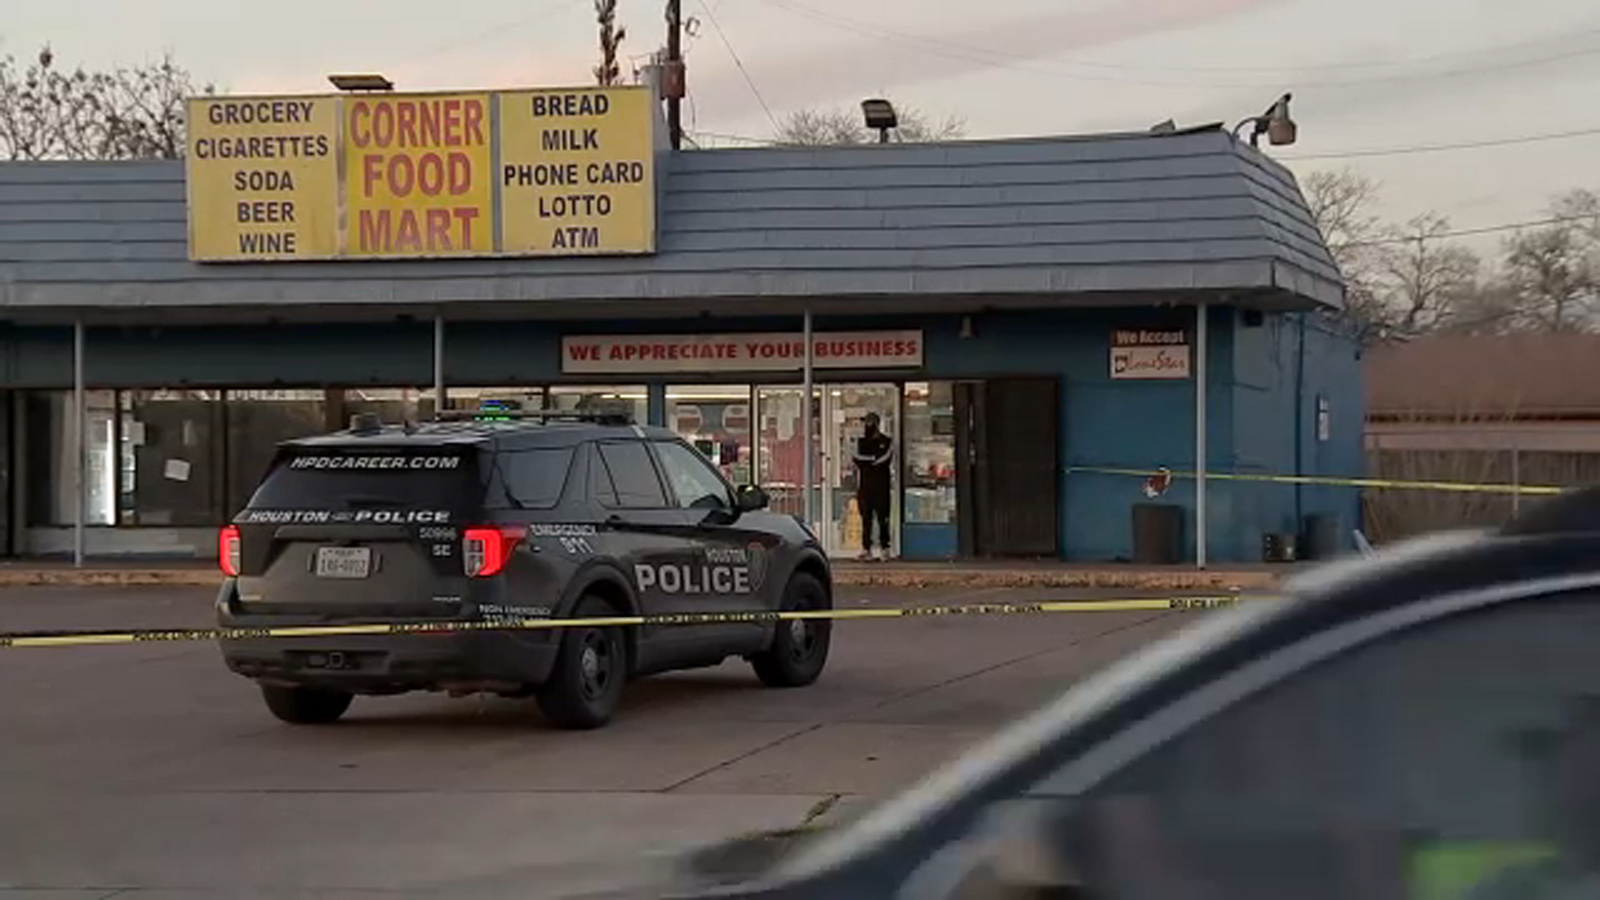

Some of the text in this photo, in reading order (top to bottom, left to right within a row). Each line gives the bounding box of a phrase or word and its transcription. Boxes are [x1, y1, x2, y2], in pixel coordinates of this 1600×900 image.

[208, 102, 314, 124] GROCERY
[532, 94, 609, 117] BREAD
[350, 99, 484, 148] CORNER
[195, 135, 329, 159] CIGARETTES
[542, 129, 599, 150] MILK
[234, 171, 294, 191] SODA
[363, 152, 471, 198] FOOD
[504, 162, 644, 186] PHONE CARD
[237, 202, 295, 223] BEER
[539, 195, 611, 217] LOTTO
[359, 207, 479, 252] MART
[551, 227, 599, 248] ATM
[239, 233, 296, 253] WINE
[1116, 330, 1184, 344] We Accept
[569, 345, 600, 361] WE
[609, 344, 737, 360] APPRECIATE
[813, 340, 917, 358] BUSINESS
[290, 456, 461, 470] HPDCAREER.COM
[249, 511, 329, 522] HOUSTON
[354, 511, 451, 522] POLICE
[635, 564, 751, 593] POLICE
